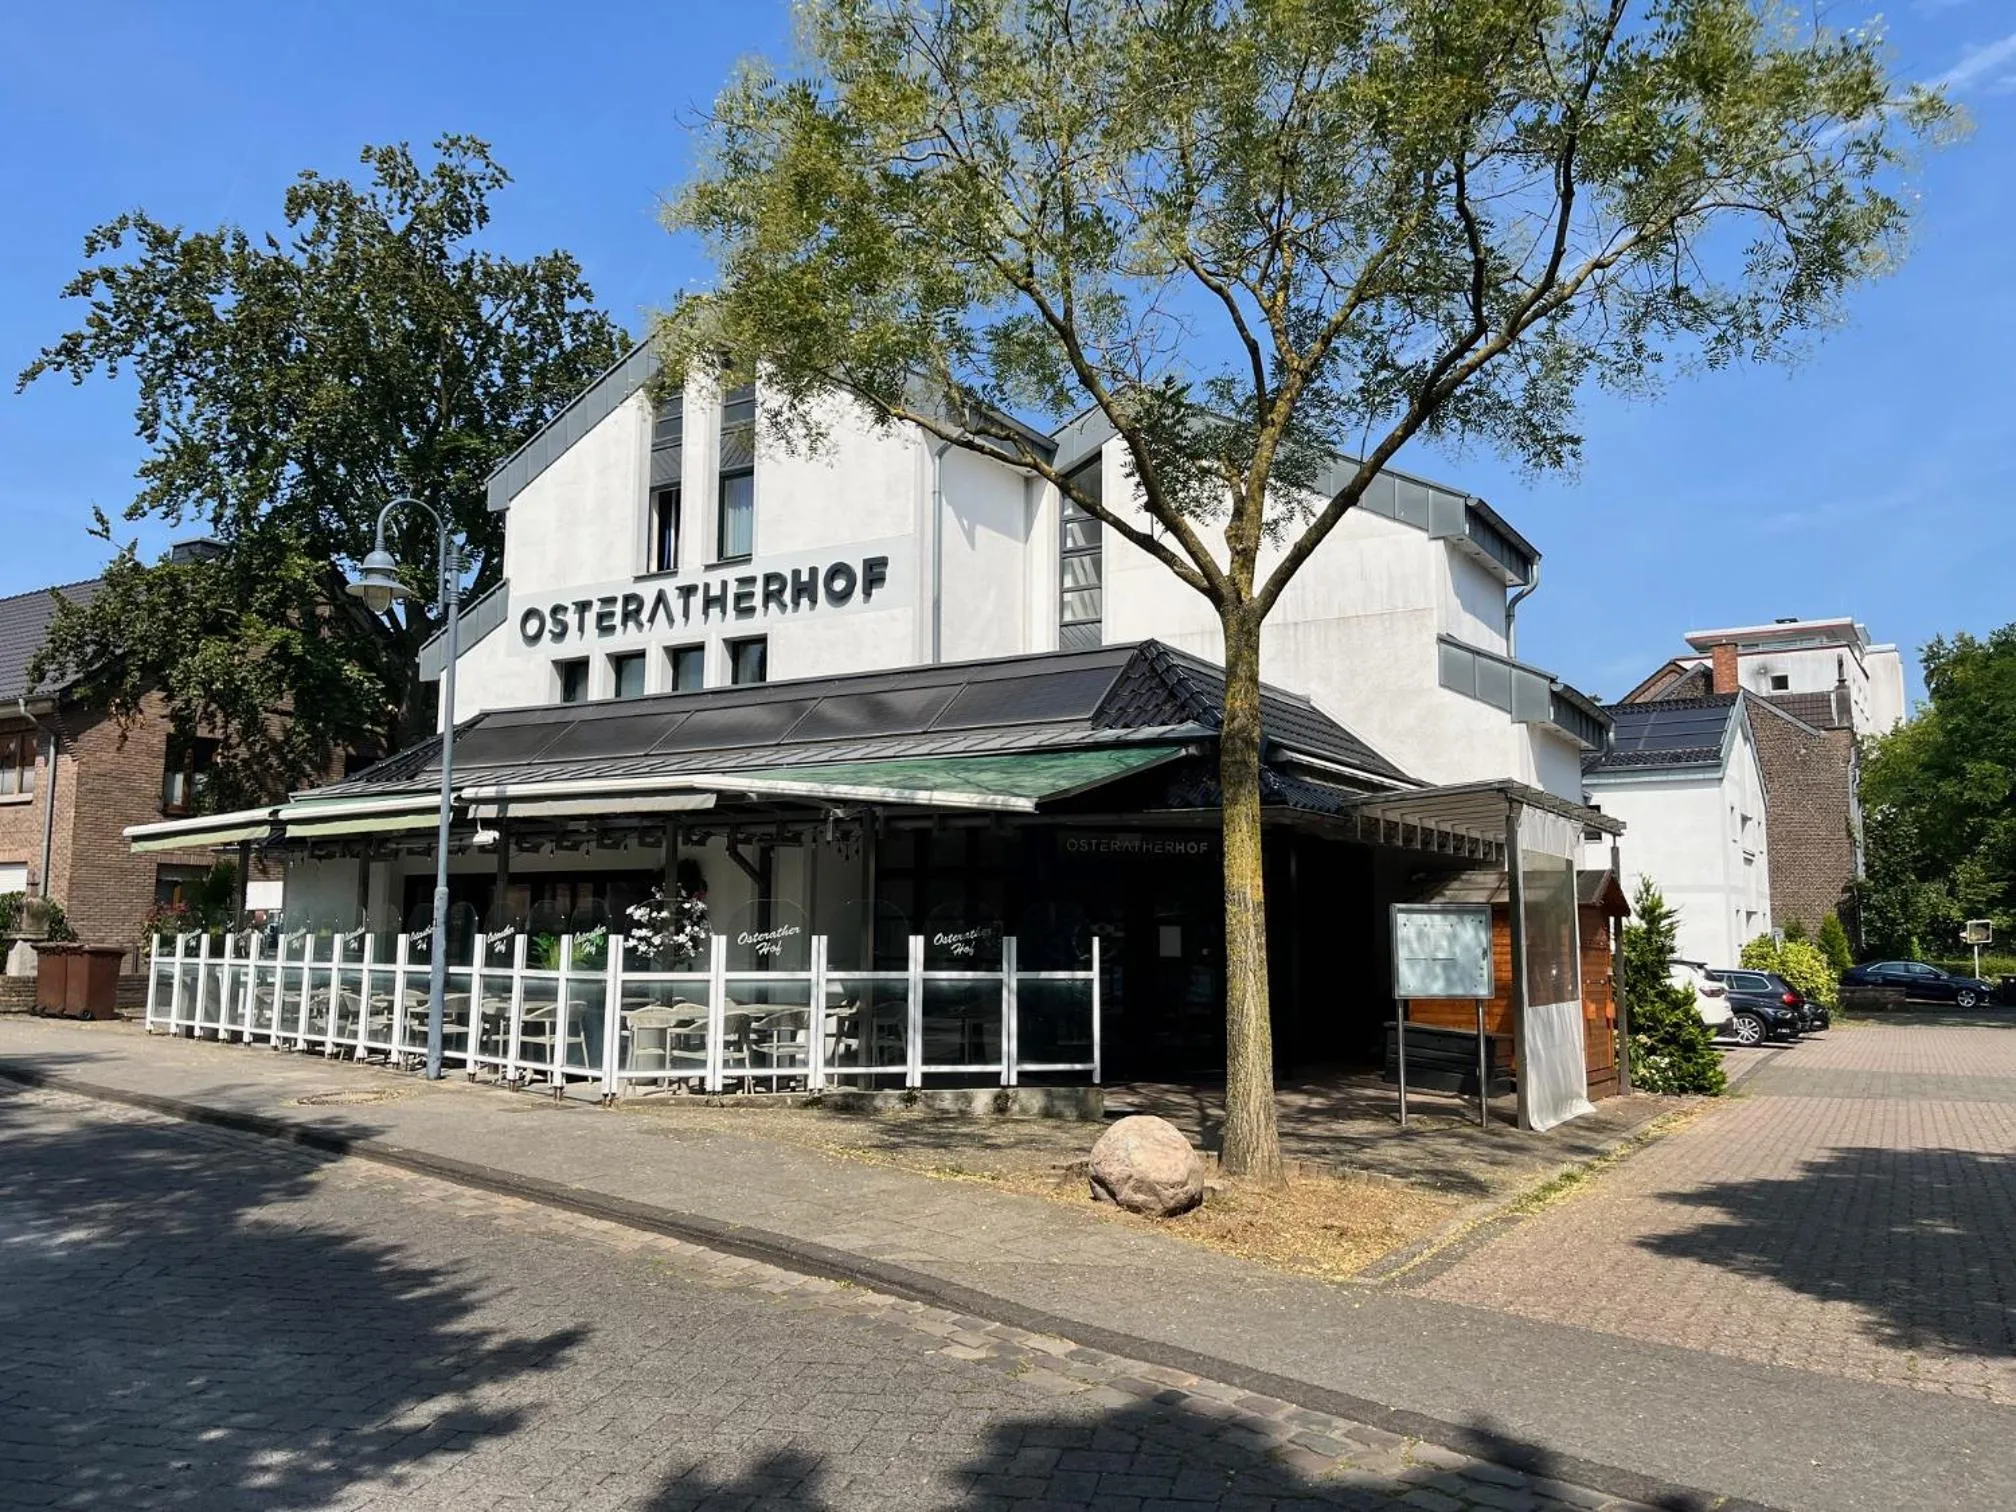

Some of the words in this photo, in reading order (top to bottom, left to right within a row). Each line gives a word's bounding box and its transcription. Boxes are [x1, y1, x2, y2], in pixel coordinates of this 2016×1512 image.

[520, 555, 890, 643] OSTERATHERHOF
[1066, 838, 1209, 854] OSTERATHERHOF
[737, 923, 801, 946] Osterather
[755, 939, 783, 957] Hof
[949, 940, 976, 957] Hof
